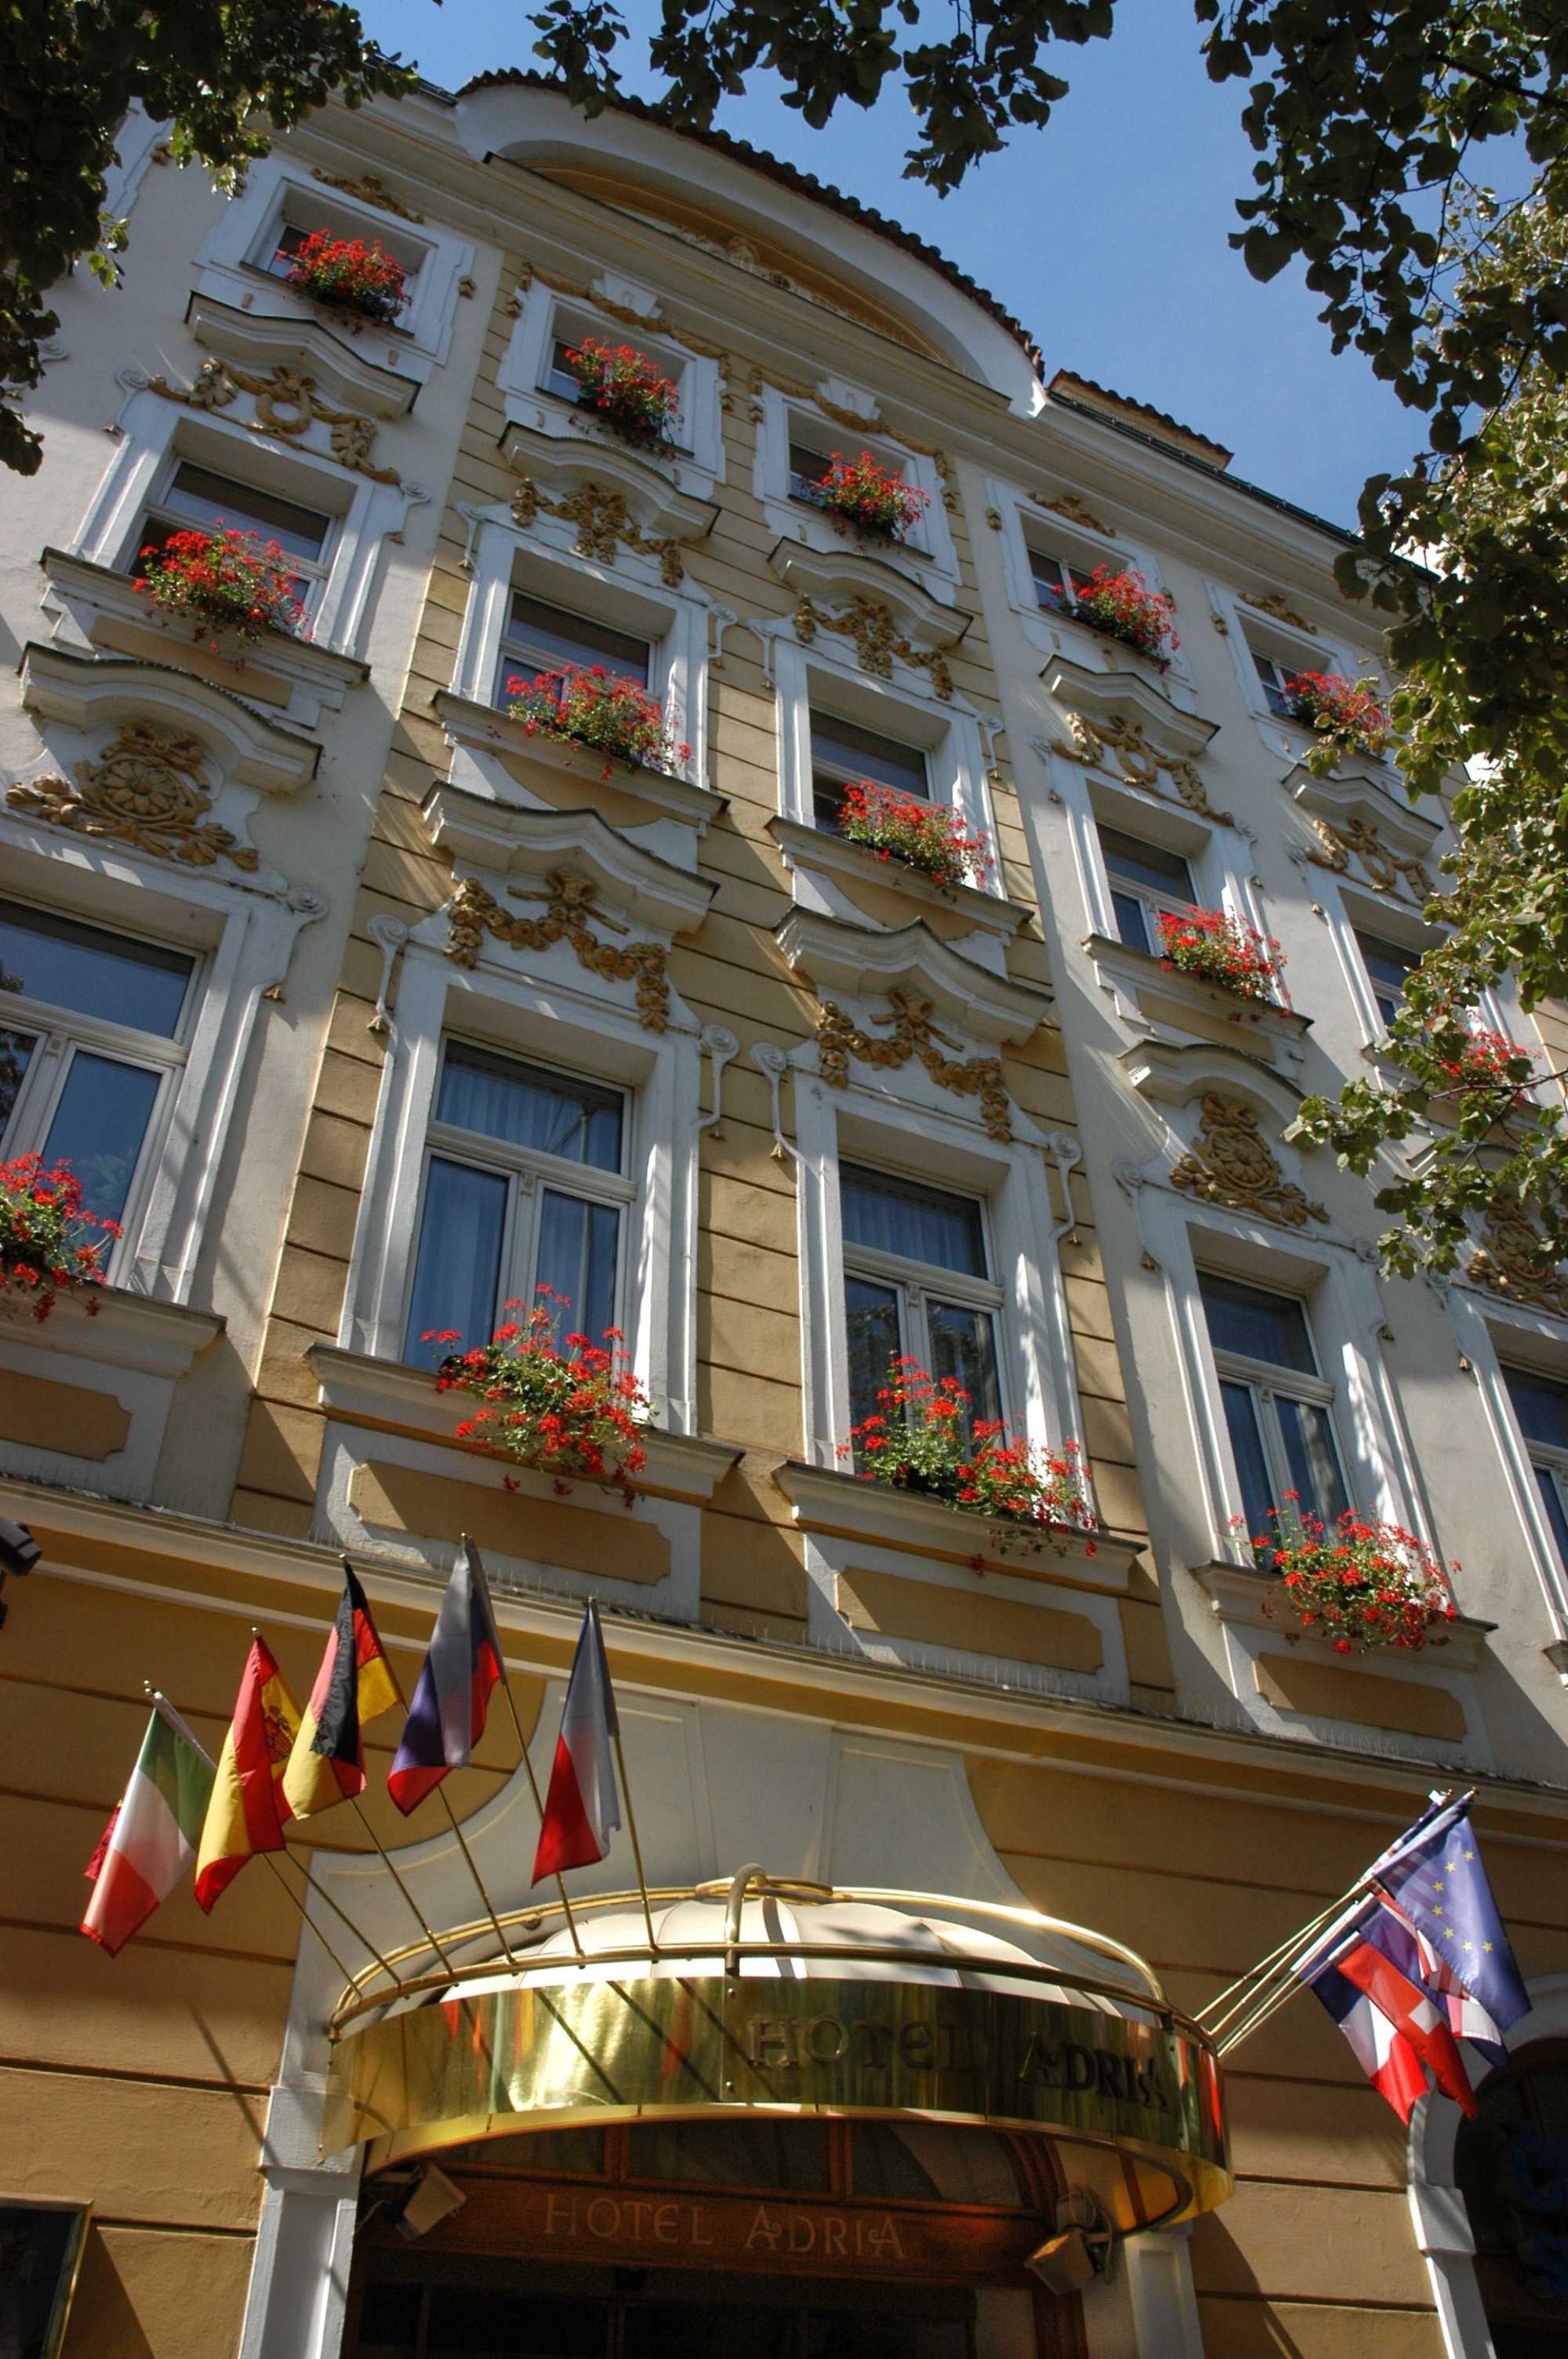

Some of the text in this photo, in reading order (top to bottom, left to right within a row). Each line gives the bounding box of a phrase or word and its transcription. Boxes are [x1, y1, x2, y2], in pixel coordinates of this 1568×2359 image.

[746, 2014, 1169, 2113] HOTEL ADRIA
[543, 2193, 905, 2259] HOTEL ADRIA
